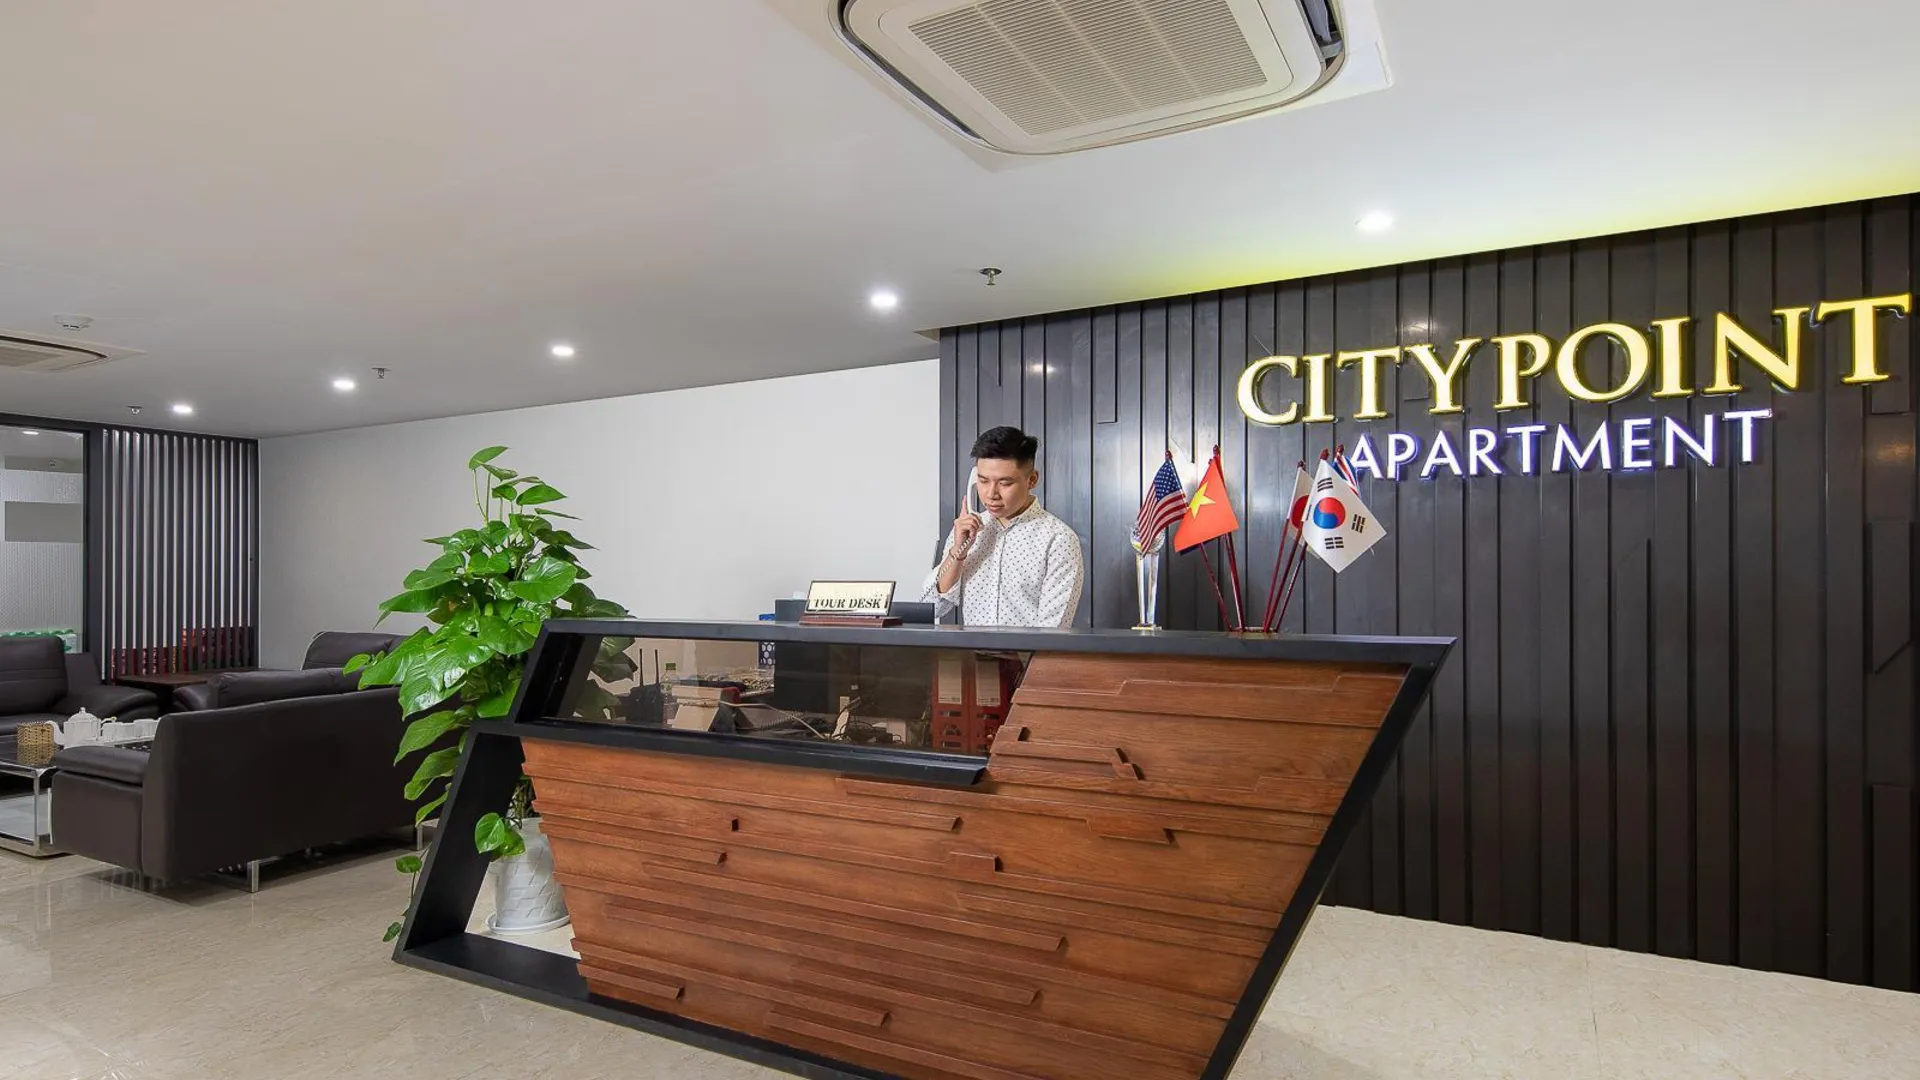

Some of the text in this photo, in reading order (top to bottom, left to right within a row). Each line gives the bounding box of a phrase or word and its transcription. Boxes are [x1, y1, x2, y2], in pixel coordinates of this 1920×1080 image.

[1236, 293, 1912, 425] CITYPOINT
[1351, 407, 1773, 480] APARTMENT
[813, 598, 882, 609] TOUR DESK
